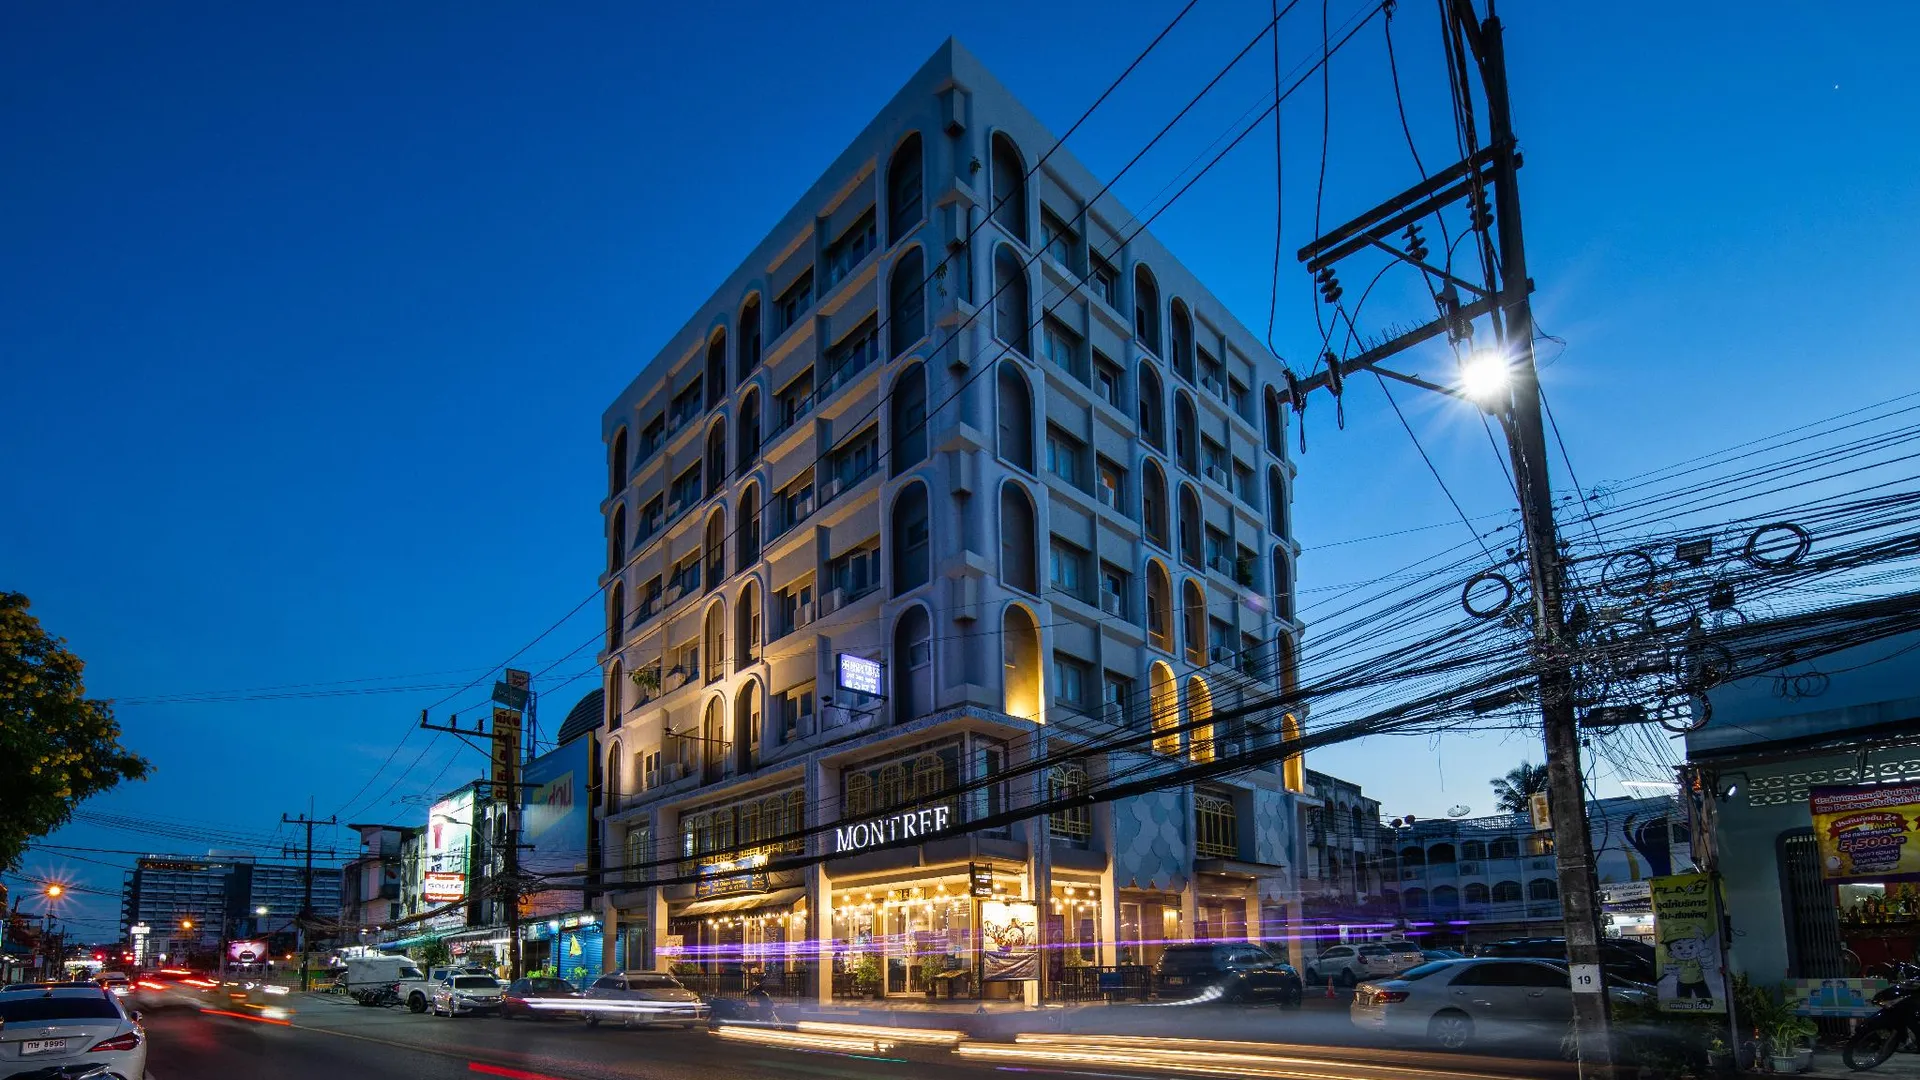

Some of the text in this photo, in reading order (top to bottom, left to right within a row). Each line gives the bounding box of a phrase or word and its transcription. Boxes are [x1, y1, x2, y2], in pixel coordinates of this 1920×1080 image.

[1884, 813, 1898, 821] 2+
[836, 806, 949, 853] MONTREE
[1578, 976, 1591, 984] 19
